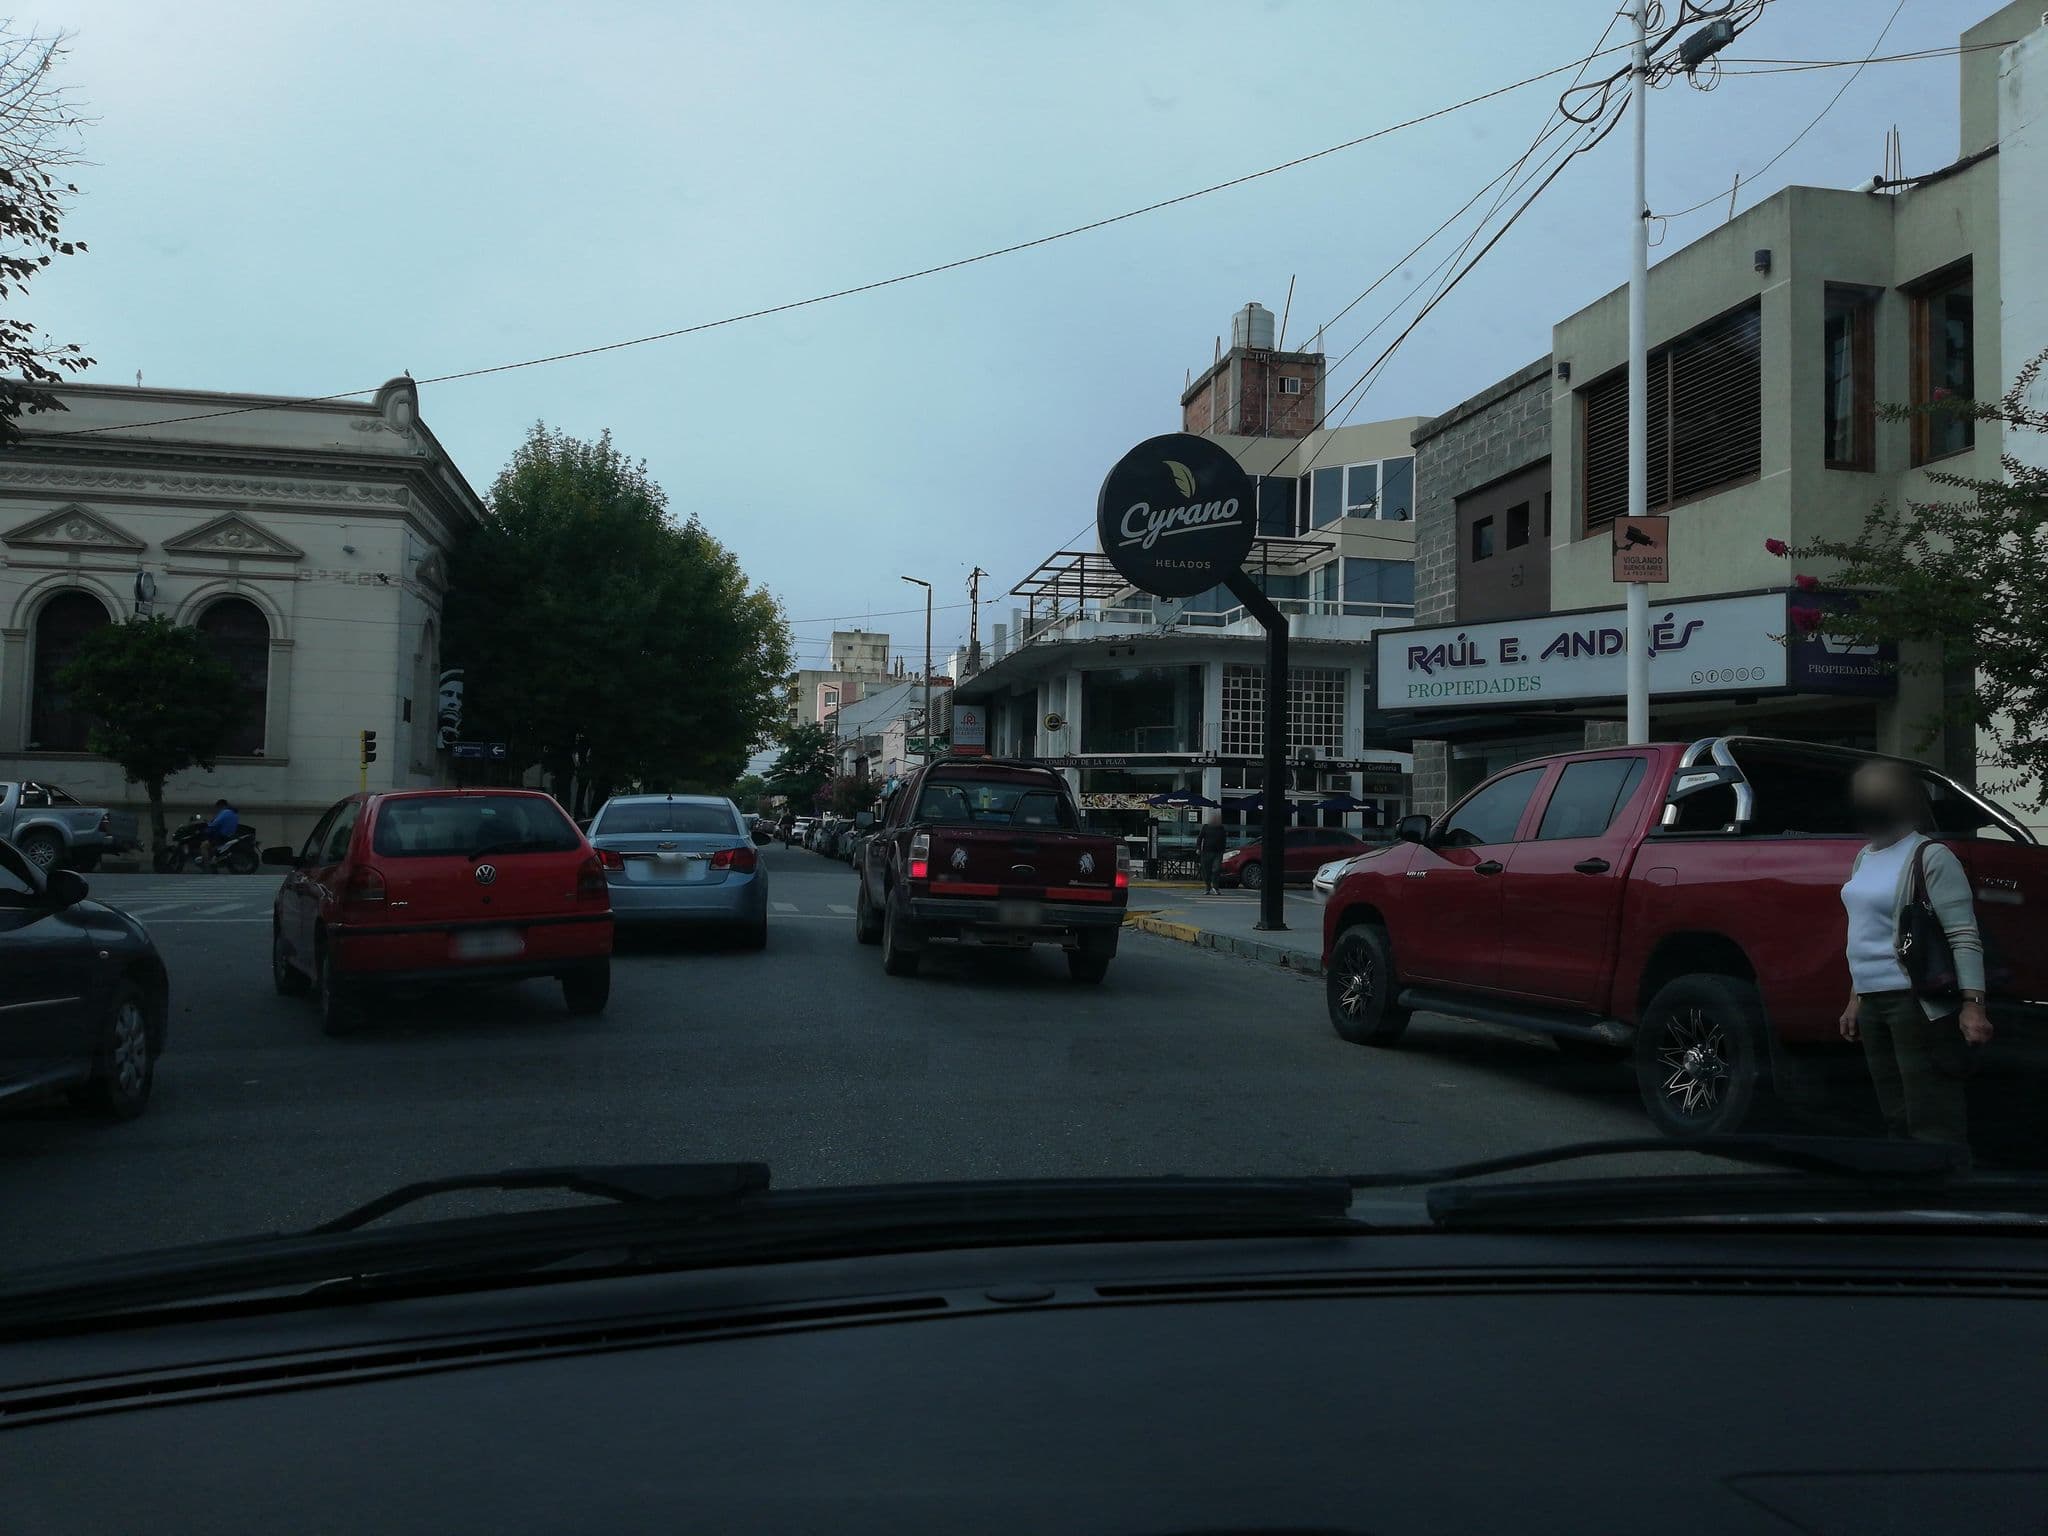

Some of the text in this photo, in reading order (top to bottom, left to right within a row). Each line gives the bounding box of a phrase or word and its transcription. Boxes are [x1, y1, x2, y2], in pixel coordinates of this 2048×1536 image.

[1120, 498, 1240, 549] Cyrano
[1156, 560, 1211, 569] HELADOS
[1624, 556, 1663, 564] VIGILANDO
[1407, 633, 1486, 675] RAÚL
[1500, 638, 1527, 663] E.
[1808, 664, 1880, 675] PROPIEDADES
[1407, 676, 1542, 699] PROPIEDADES
